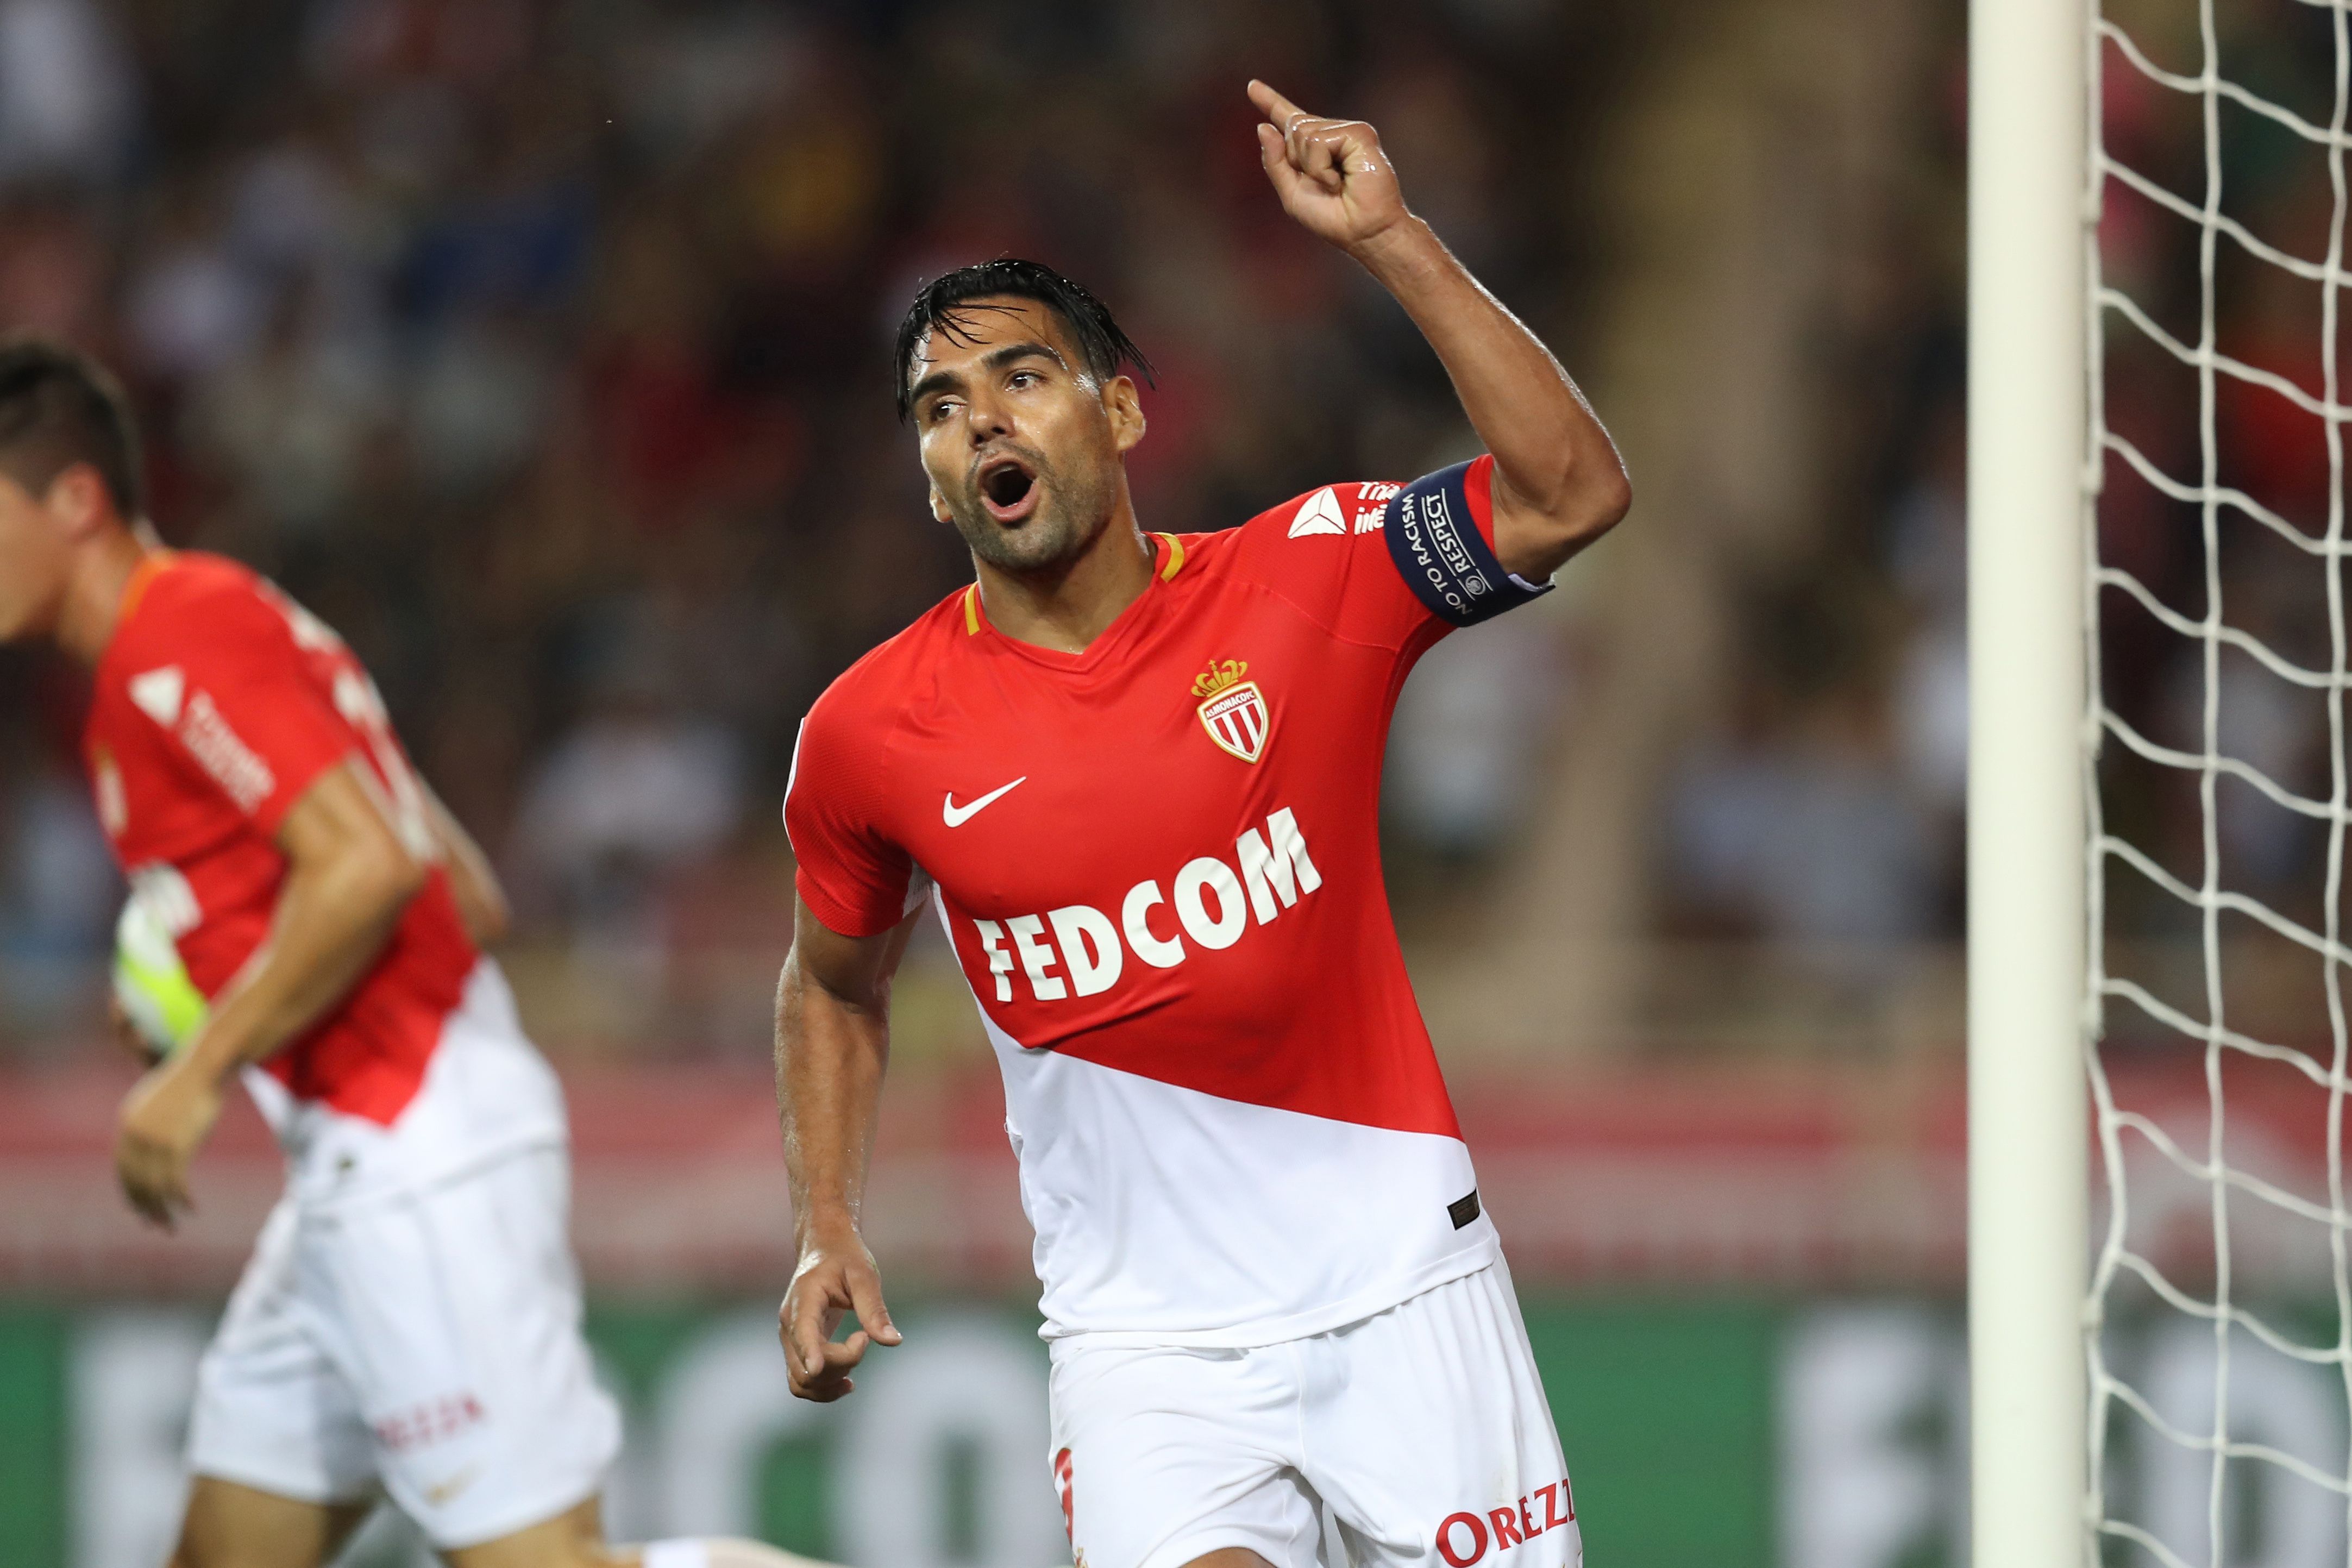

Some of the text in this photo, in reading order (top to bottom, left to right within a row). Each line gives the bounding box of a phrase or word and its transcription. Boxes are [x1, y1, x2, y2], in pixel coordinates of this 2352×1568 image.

[1402, 493, 1472, 614] NO TO RACISM
[1426, 494, 1471, 574] RESPECT
[973, 806, 1322, 1002] FEDCOM
